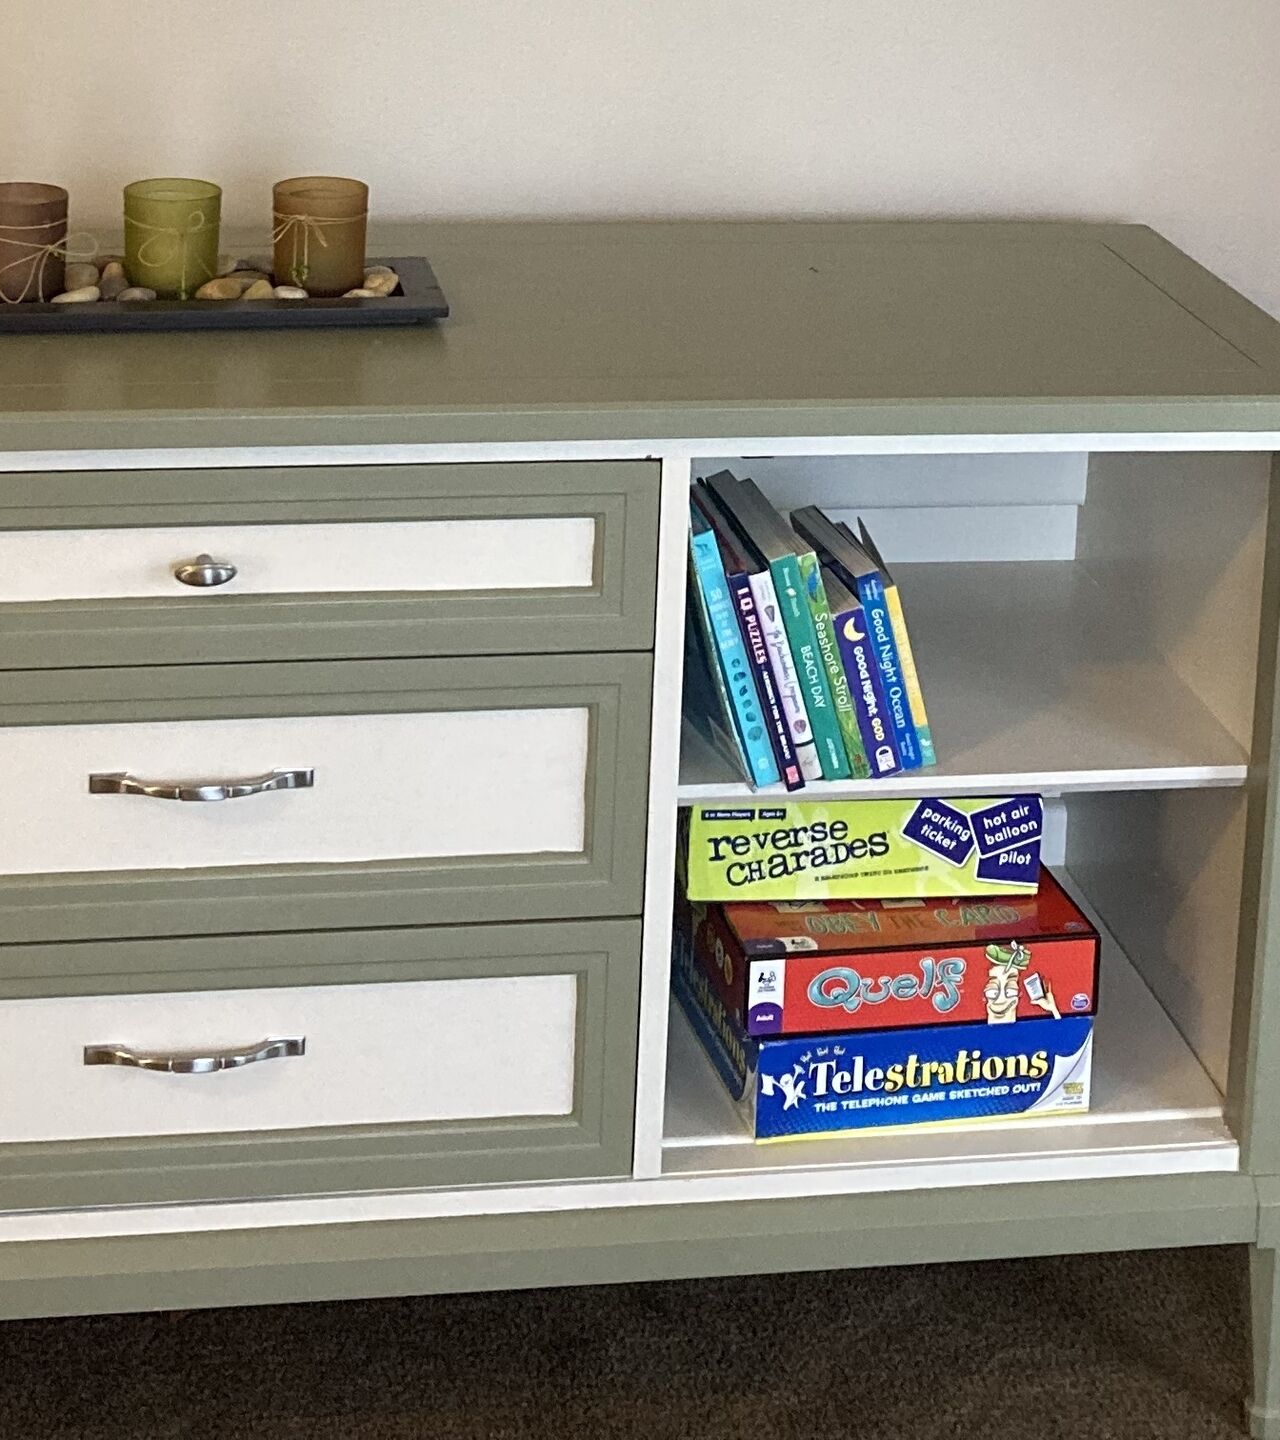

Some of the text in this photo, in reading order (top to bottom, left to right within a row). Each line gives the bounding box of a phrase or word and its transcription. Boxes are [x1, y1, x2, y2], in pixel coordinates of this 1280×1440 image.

[745, 614, 768, 665] PUZZLES
[871, 608, 890, 643] Good
[801, 645, 827, 708] BEACH DAY
[815, 612, 852, 713] Seashore Stroll
[879, 642, 898, 684] Night
[889, 687, 906, 729] Ocean
[871, 717, 885, 742] GOD
[920, 807, 971, 842] parking
[983, 805, 1030, 830] hot air
[984, 820, 1038, 846] balloon
[707, 820, 848, 862] reverse
[920, 824, 957, 850] ticket
[998, 850, 1032, 866] pilot
[807, 956, 967, 1013] Quelf
[809, 1050, 1049, 1097] Telestrations
[814, 1082, 1042, 1112] THE TELEPHONE GAME SKETCHED OUT!
